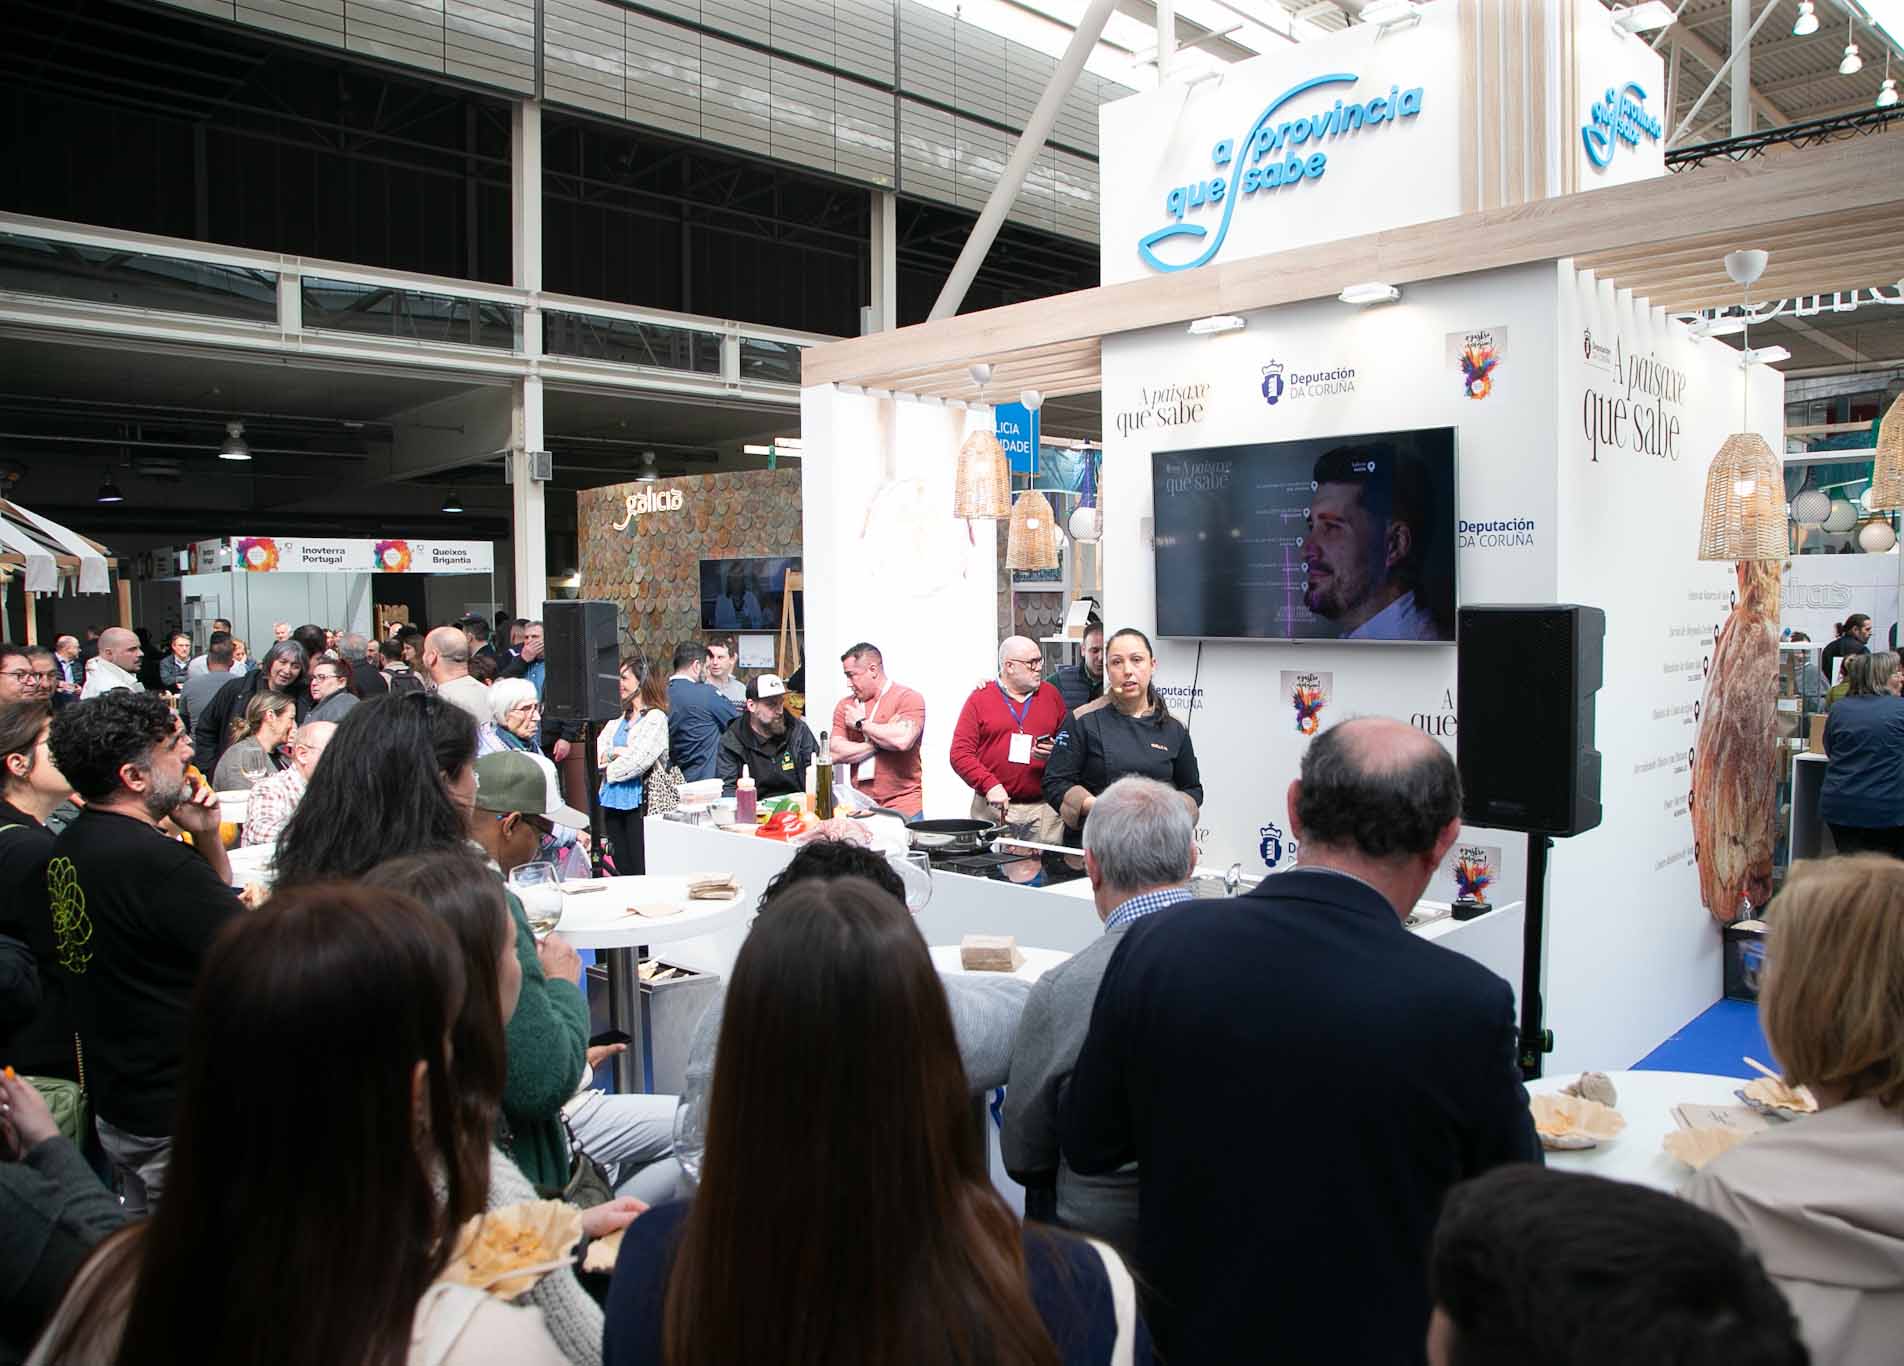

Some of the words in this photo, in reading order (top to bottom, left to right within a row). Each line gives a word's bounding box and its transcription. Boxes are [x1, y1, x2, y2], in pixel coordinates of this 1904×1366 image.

[1212, 137, 1234, 164] a
[1253, 85, 1424, 163] provincia
[1166, 177, 1226, 218] que
[1242, 150, 1328, 193] sabe
[1613, 336, 1623, 385] A
[1290, 367, 1355, 387] Deputación
[1290, 387, 1305, 400] DA
[1116, 409, 1152, 438] que
[1157, 399, 1204, 426] sabe
[1584, 388, 1627, 462] que
[1633, 398, 1681, 462] sabe
[995, 422, 1020, 434] LICIA
[1000, 438, 1030, 454] IDADE
[613, 485, 683, 531] galicia
[1459, 518, 1534, 536] Deputación
[1459, 536, 1475, 548] DA
[1480, 531, 1534, 547] CORUÑA
[302, 546, 346, 554] Inovterra
[432, 548, 467, 556] Queixos
[302, 555, 343, 564] Portugal
[432, 556, 471, 565] Brigantia
[1152, 685, 1203, 697] eputación
[1441, 688, 1453, 710] A
[1410, 712, 1457, 737] que
